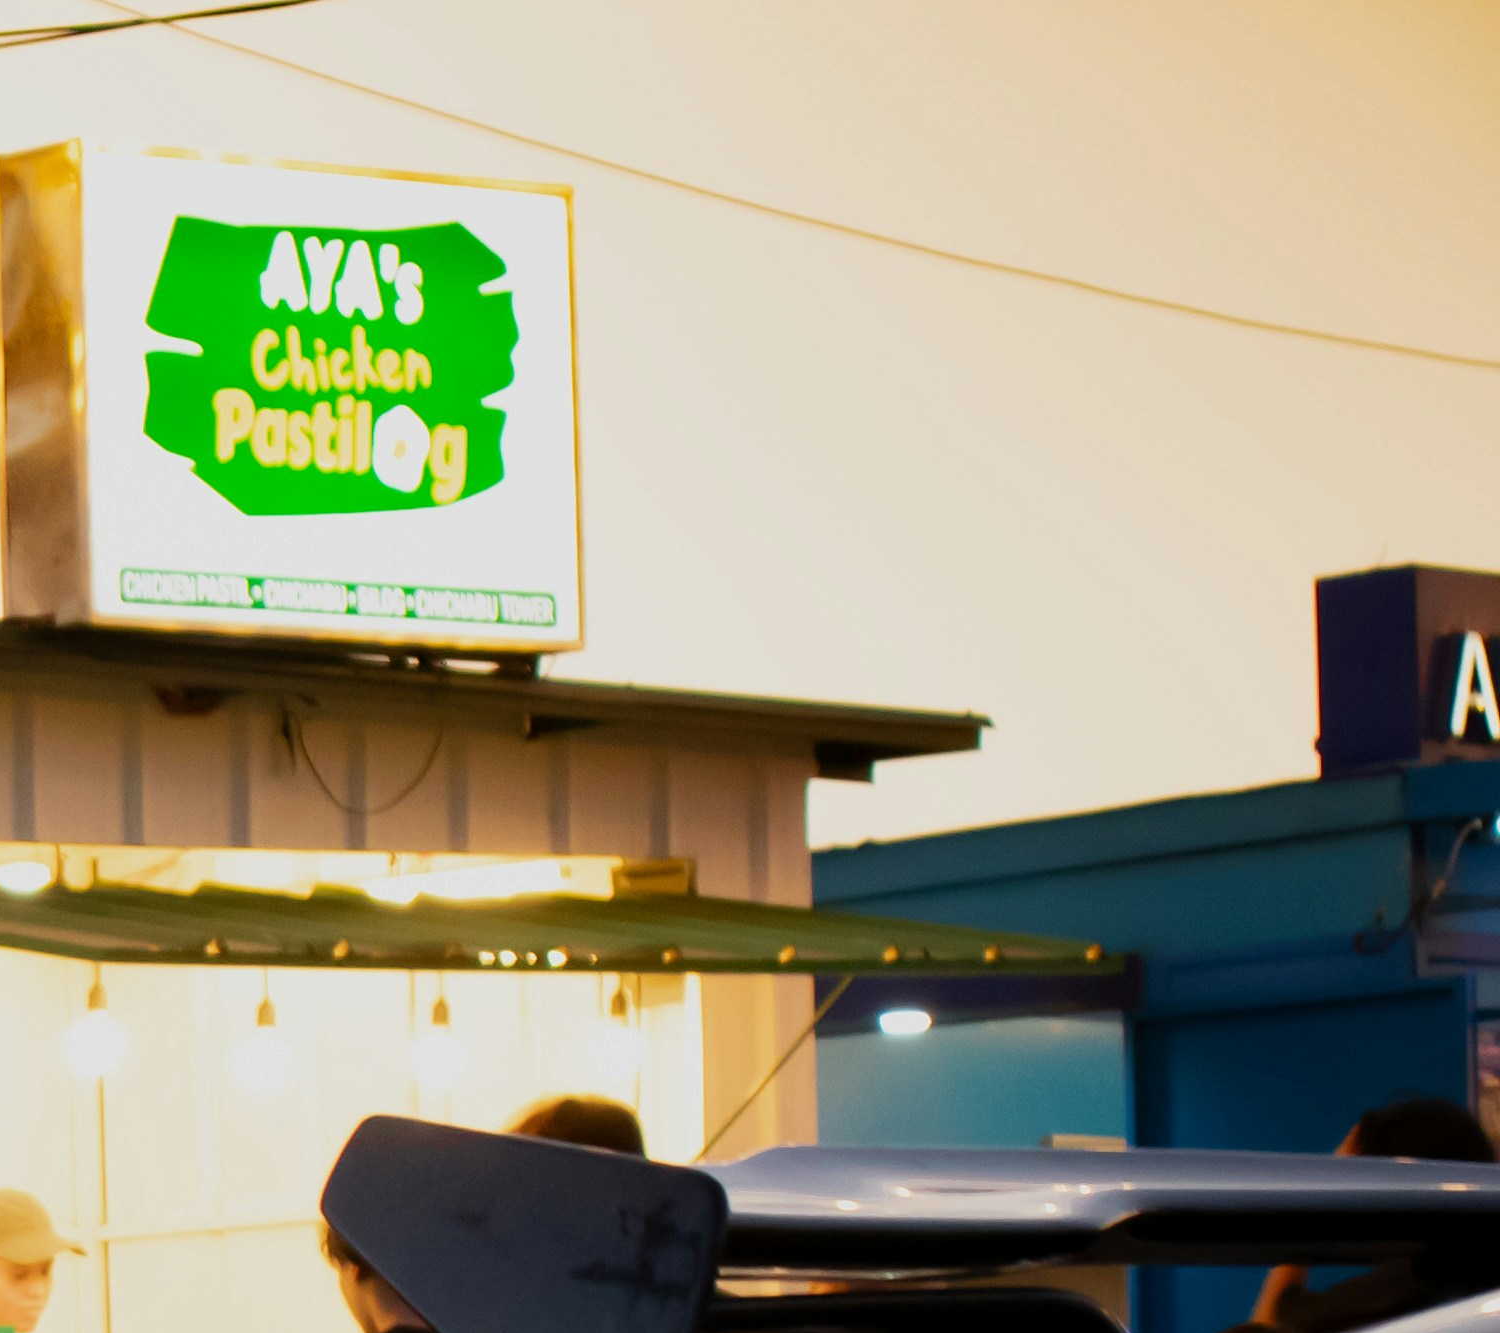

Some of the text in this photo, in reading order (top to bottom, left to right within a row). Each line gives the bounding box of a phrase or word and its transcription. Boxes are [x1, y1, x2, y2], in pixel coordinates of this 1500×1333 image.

[260, 230, 424, 325] AYA's
[251, 326, 431, 395] Chicken
[123, 571, 195, 602] CHICKEN
[197, 575, 253, 606] PASTIL
[500, 594, 554, 624] TOWER
